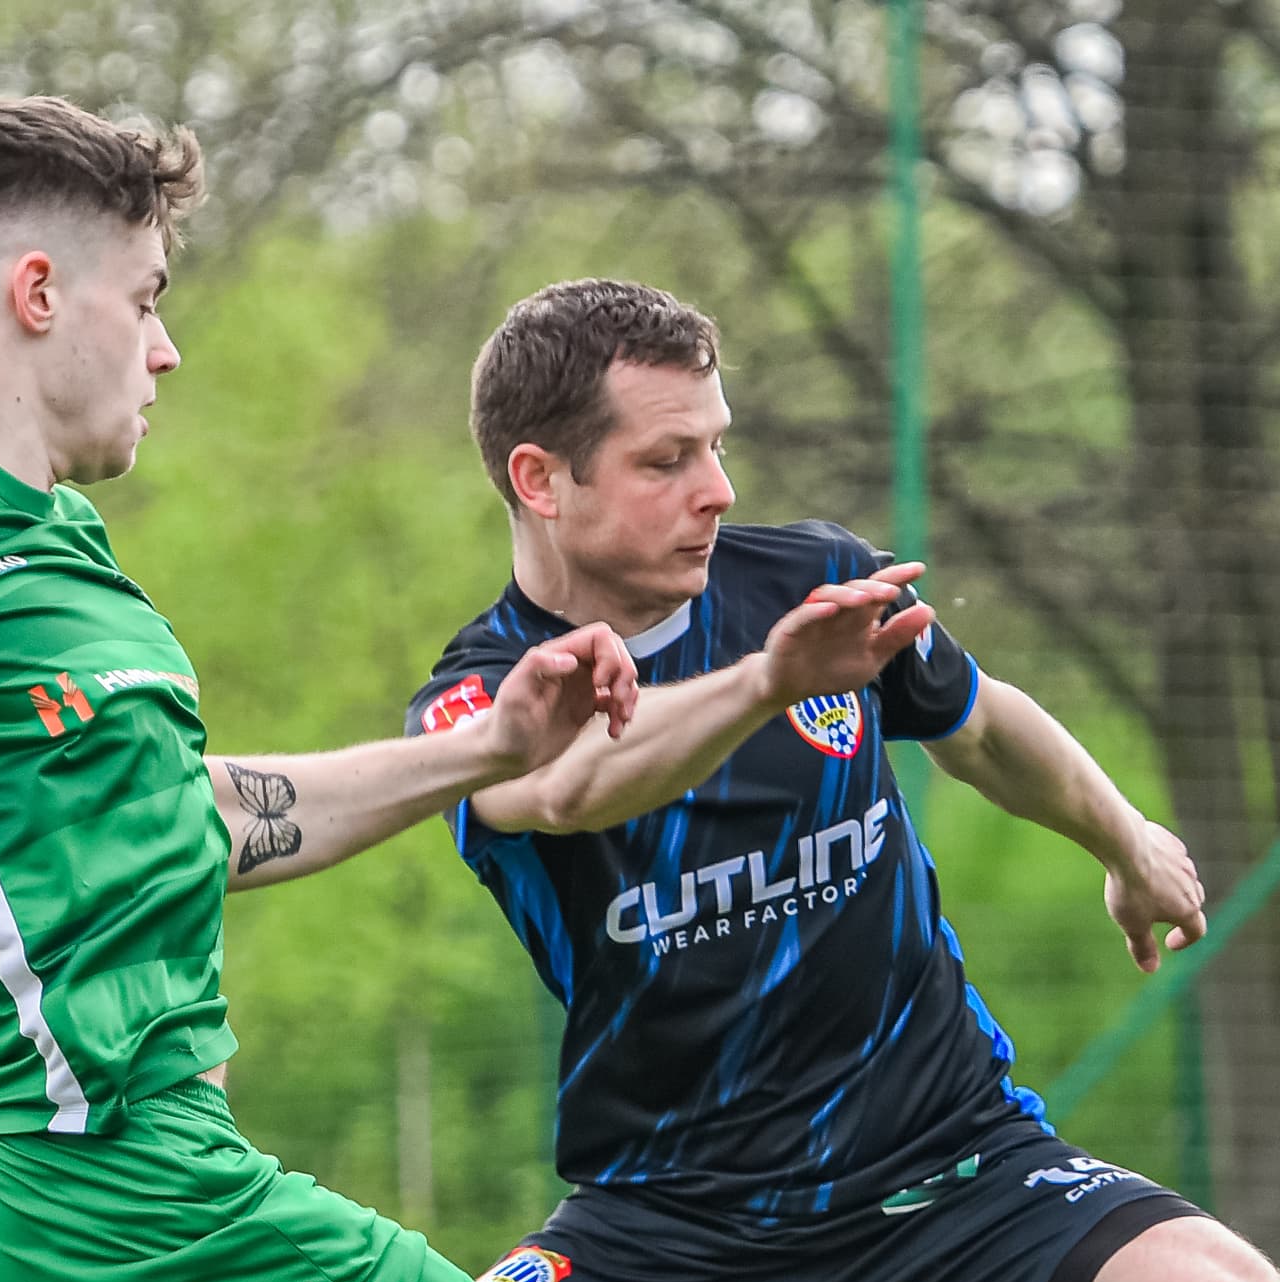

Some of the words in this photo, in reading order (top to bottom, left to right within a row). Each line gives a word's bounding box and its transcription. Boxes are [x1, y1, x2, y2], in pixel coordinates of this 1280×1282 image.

[606, 798, 889, 943] CUTLINE
[652, 918, 732, 957] WEAR
[743, 877, 858, 929] FACTOR
